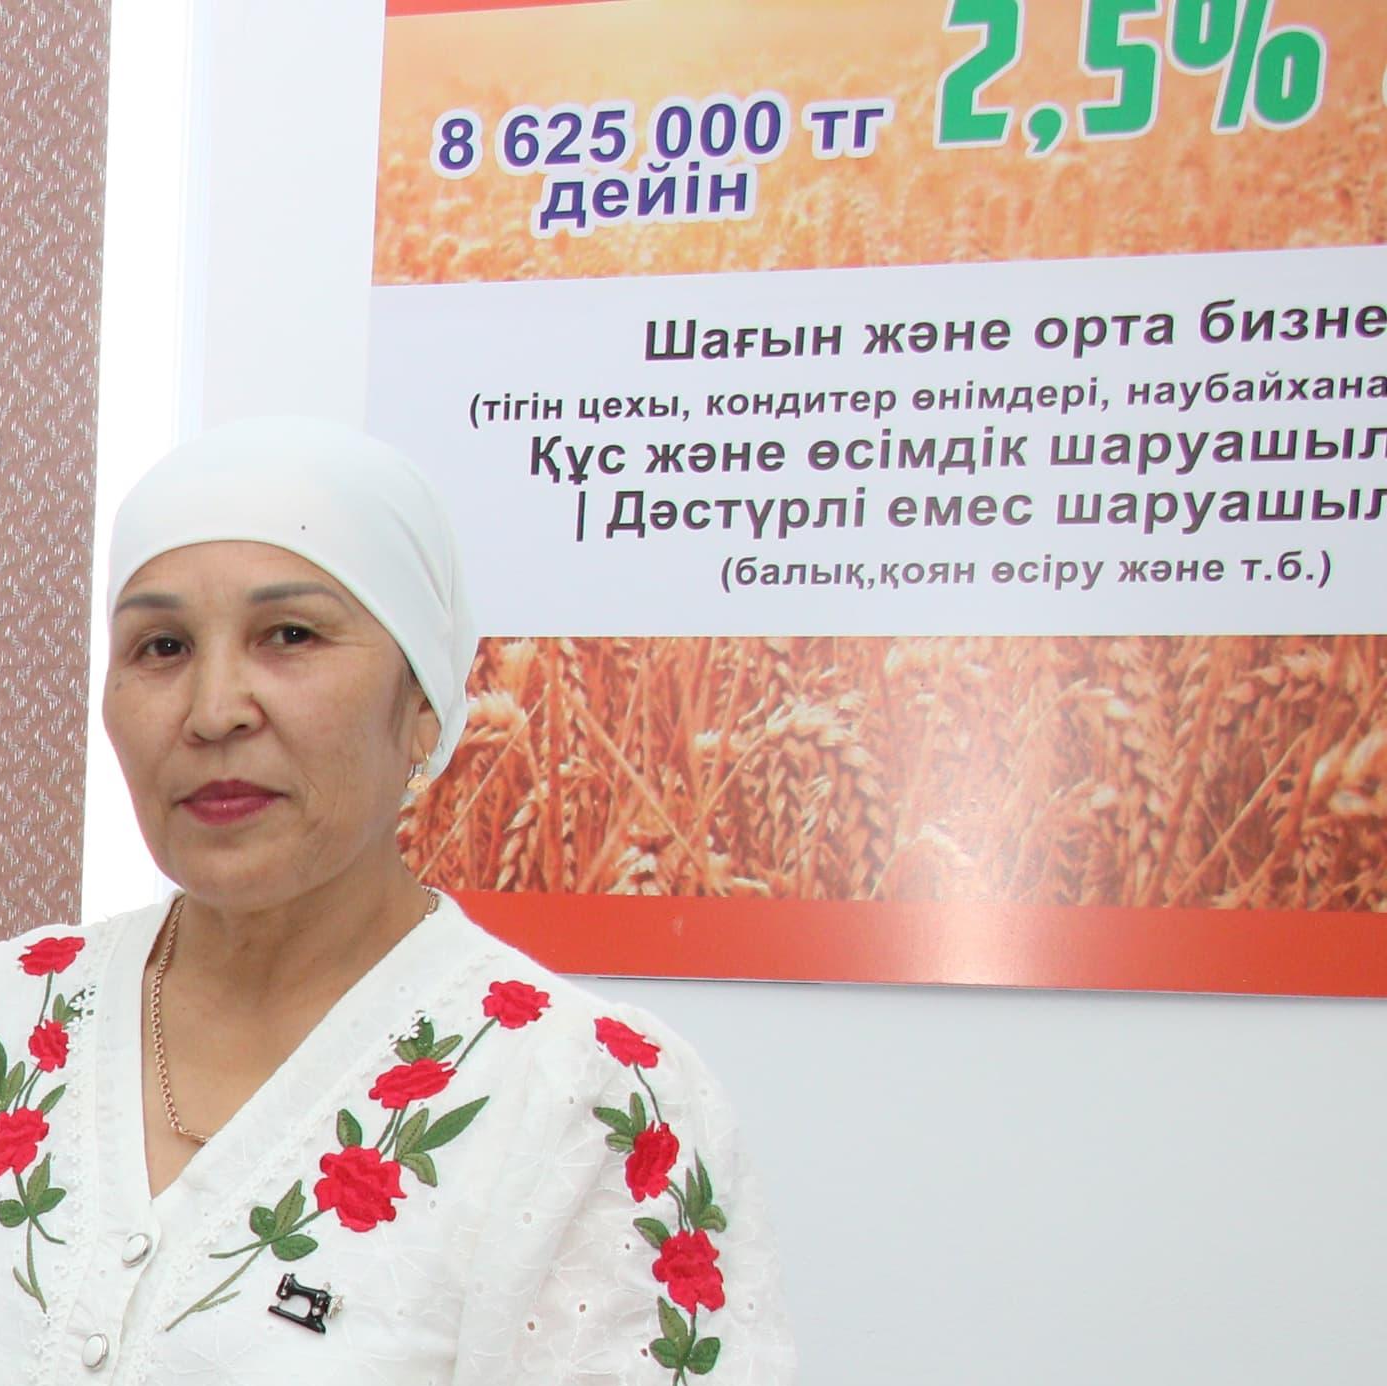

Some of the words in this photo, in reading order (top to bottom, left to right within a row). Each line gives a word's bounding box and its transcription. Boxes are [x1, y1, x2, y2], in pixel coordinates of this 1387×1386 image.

[936, 0, 1324, 155] 2,5%
[437, 117, 476, 172] 8
[502, 108, 628, 168] 625
[654, 99, 783, 161] 000
[809, 106, 885, 152] тг
[538, 160, 750, 231] дейін
[644, 318, 843, 362] Шағын
[862, 315, 1012, 355] және
[1033, 312, 1175, 359] орта
[468, 392, 565, 429] (тігін
[577, 393, 691, 424] цехы,
[705, 386, 897, 420] кондитер
[911, 376, 1111, 415] өнімдері,
[529, 433, 627, 486] Құс
[644, 437, 786, 475] және
[806, 424, 1028, 476] өсімдік
[605, 486, 867, 541] Дәстүрлі
[886, 491, 1034, 528] емес
[720, 556, 976, 593] (балық,қоян
[990, 553, 1105, 592] өсіру
[1116, 557, 1226, 584] және
[1239, 549, 1332, 590] т.б.)
